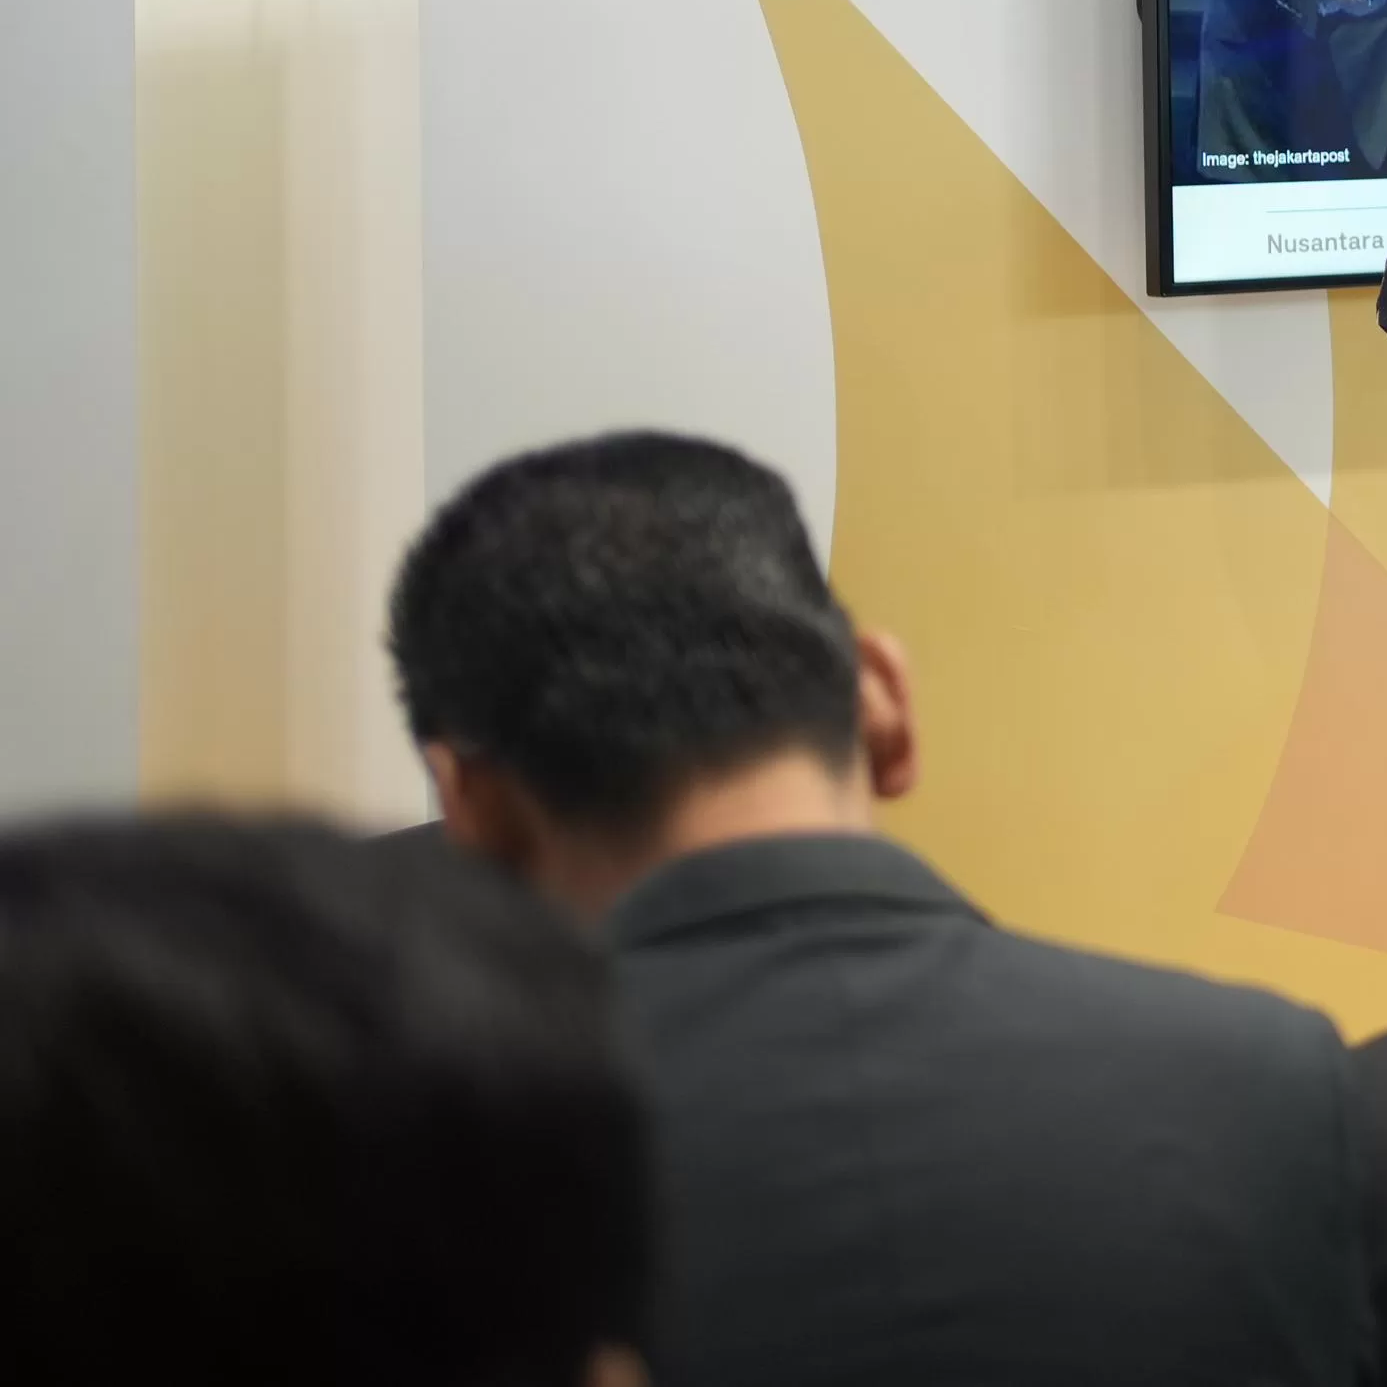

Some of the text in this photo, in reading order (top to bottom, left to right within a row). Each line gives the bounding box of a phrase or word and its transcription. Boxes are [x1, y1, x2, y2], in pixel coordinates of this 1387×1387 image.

[1202, 148, 1351, 169] Image: thejakartapost
[1267, 232, 1385, 255] Nusantara
